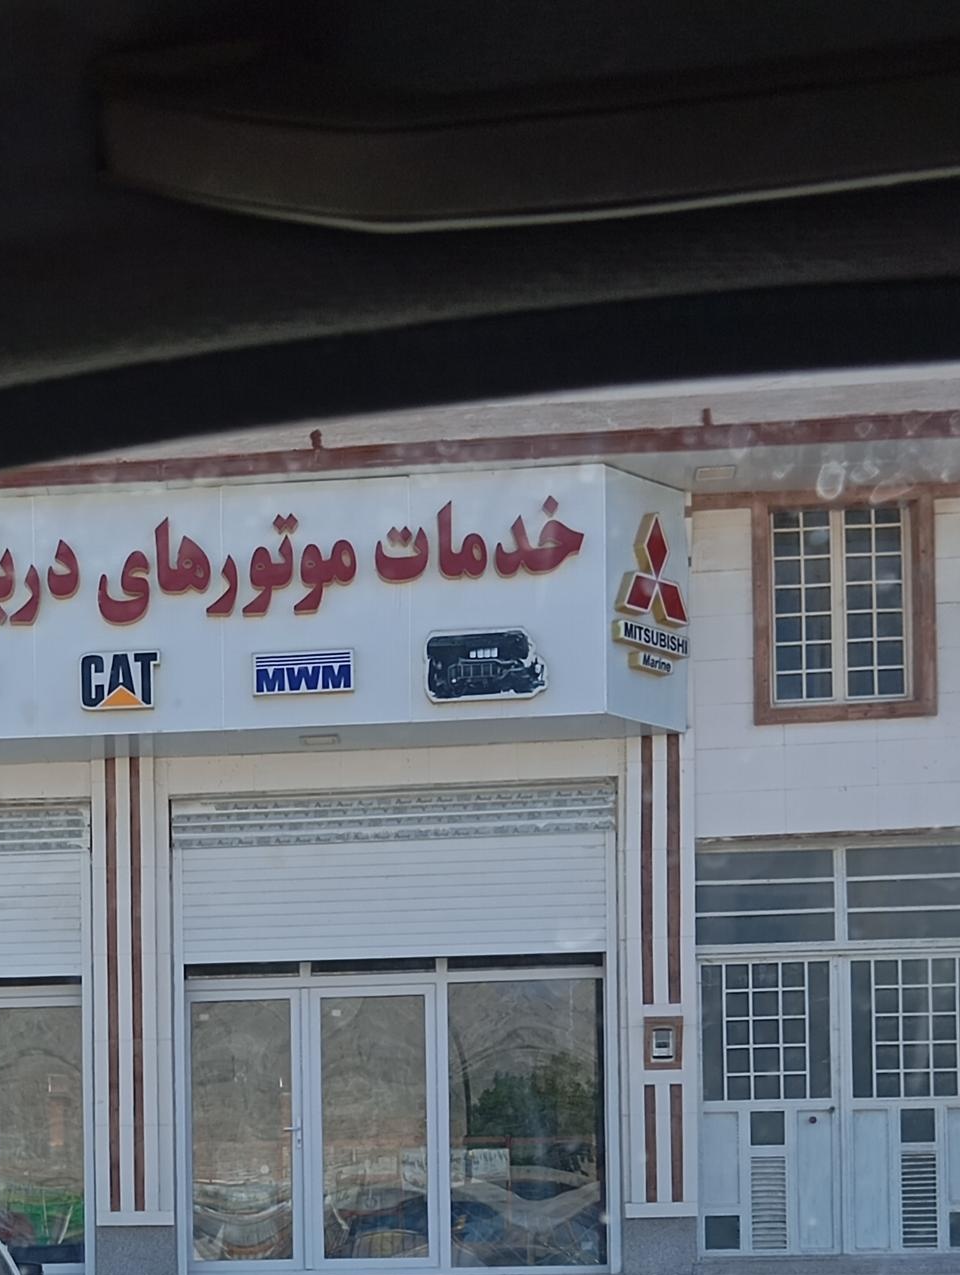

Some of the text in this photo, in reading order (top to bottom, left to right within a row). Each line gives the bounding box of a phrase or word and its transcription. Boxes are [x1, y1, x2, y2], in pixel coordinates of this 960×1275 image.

[375, 495, 585, 583] خدمات
[97, 513, 357, 626] موتورهای
[624, 621, 688, 655] MITSUBISHI
[81, 652, 158, 707] CAT
[256, 663, 351, 693] MWM
[642, 653, 672, 673] Marine
